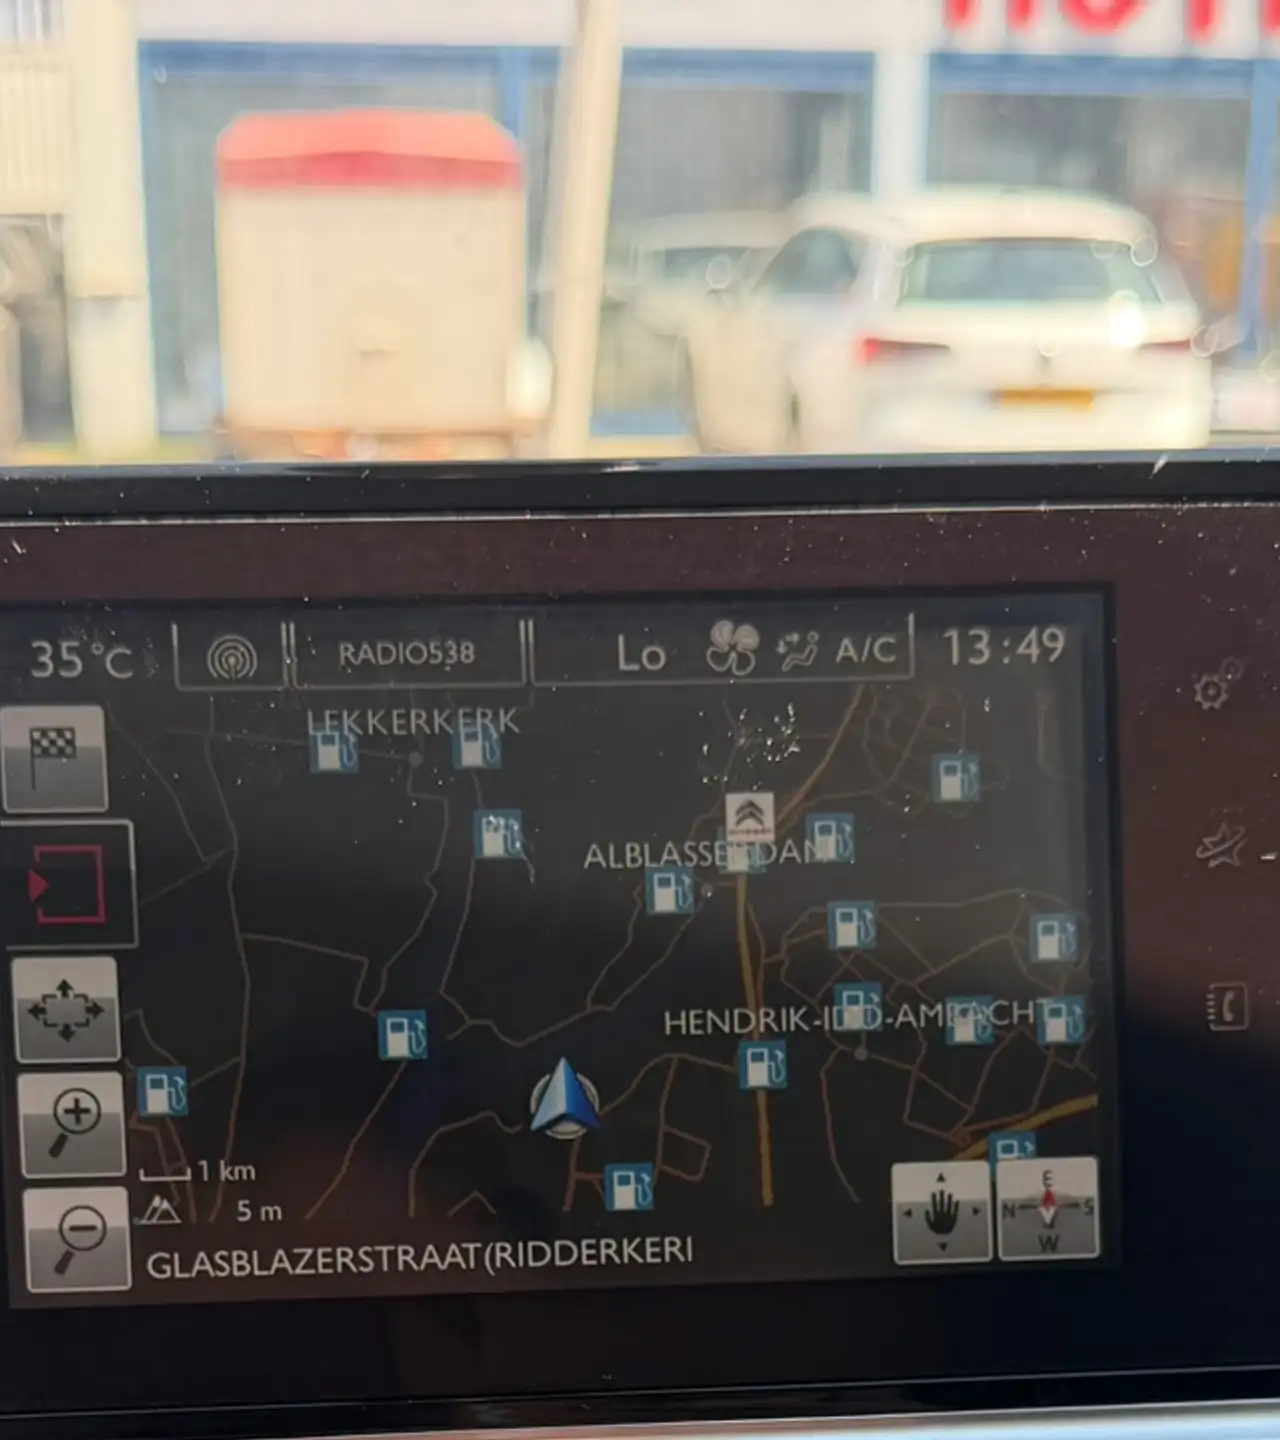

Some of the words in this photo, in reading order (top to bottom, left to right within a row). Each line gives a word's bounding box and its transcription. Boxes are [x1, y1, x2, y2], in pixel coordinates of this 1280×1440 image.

[338, 640, 476, 667] RADIO538
[617, 634, 667, 672] Lo
[836, 635, 897, 665] A/C
[943, 625, 1067, 666] 13:49
[307, 707, 522, 736] LEKKERKERK
[219, 1160, 256, 1181] km
[237, 1200, 251, 1222] 5
[260, 1204, 282, 1221] m
